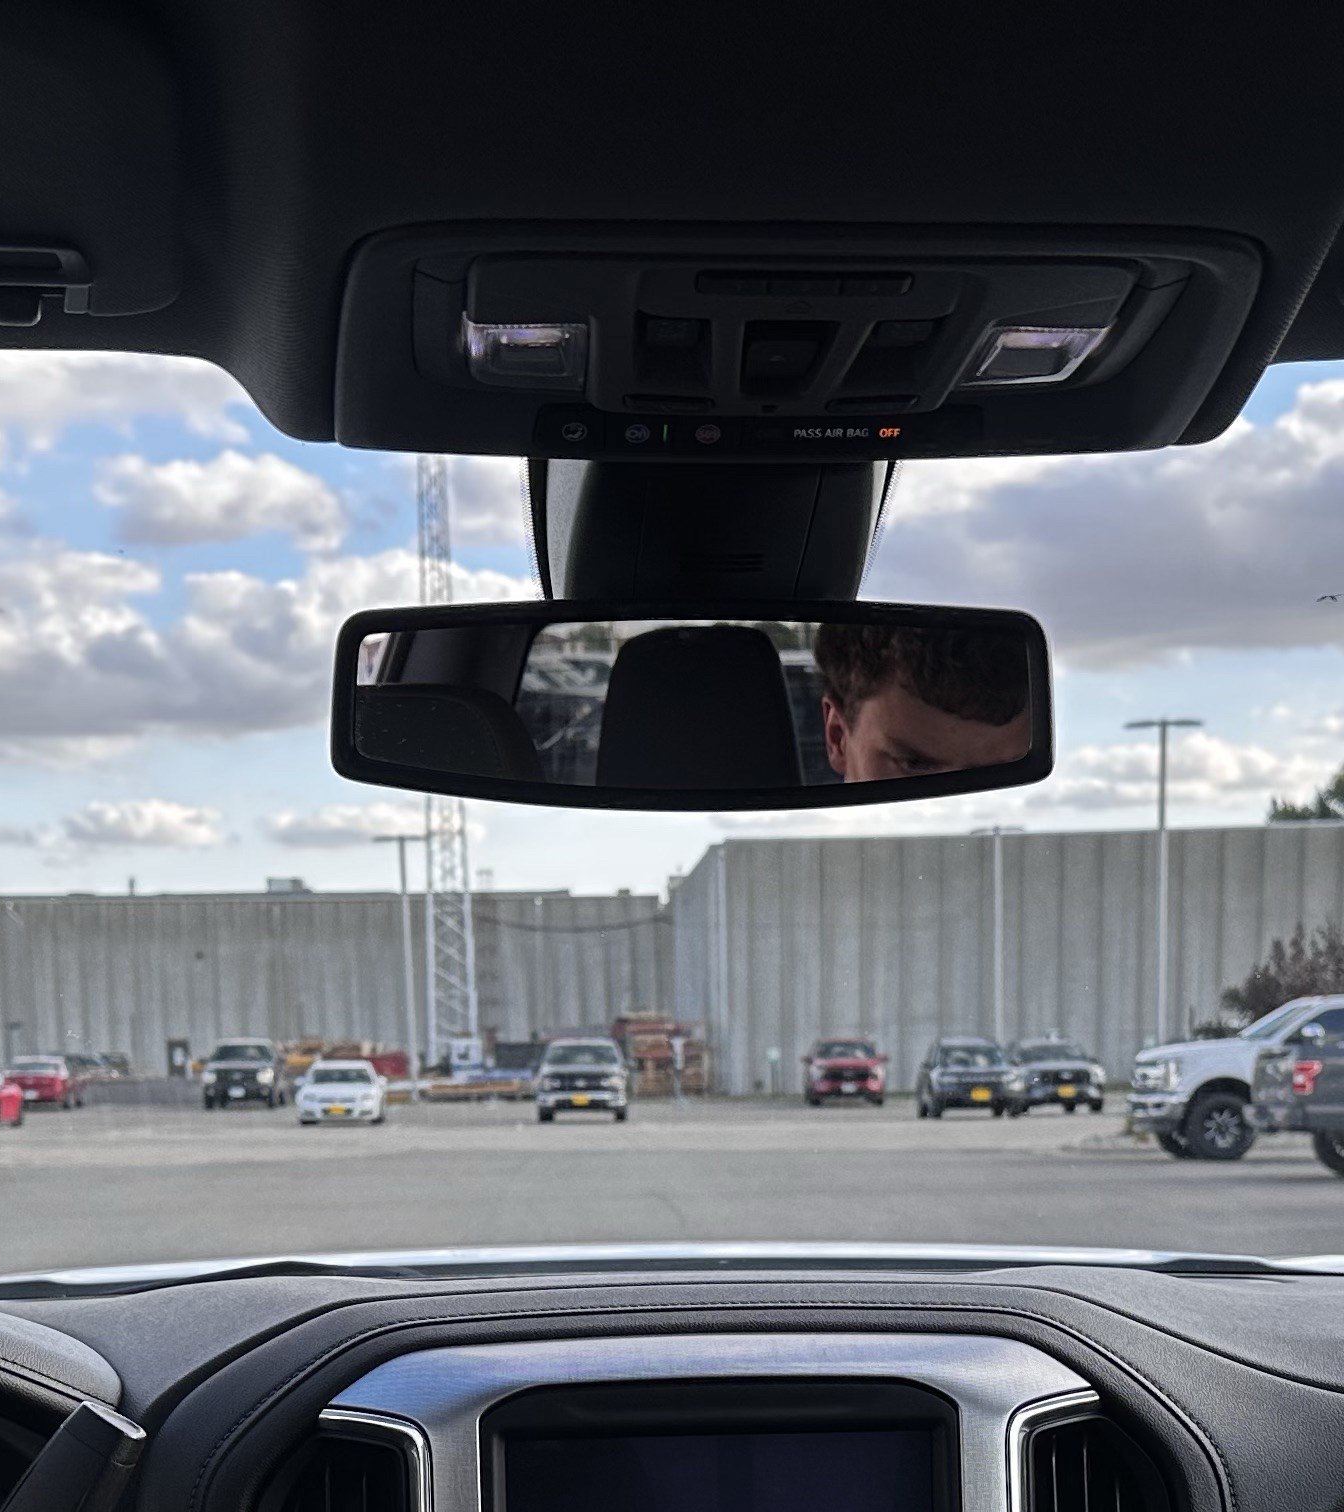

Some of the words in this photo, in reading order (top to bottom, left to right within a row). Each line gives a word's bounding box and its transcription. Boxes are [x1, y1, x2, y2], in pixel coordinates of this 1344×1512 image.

[793, 428, 822, 438] PASS
[824, 428, 844, 438] AIR
[846, 428, 870, 439] BAG
[877, 427, 902, 438] OFF
